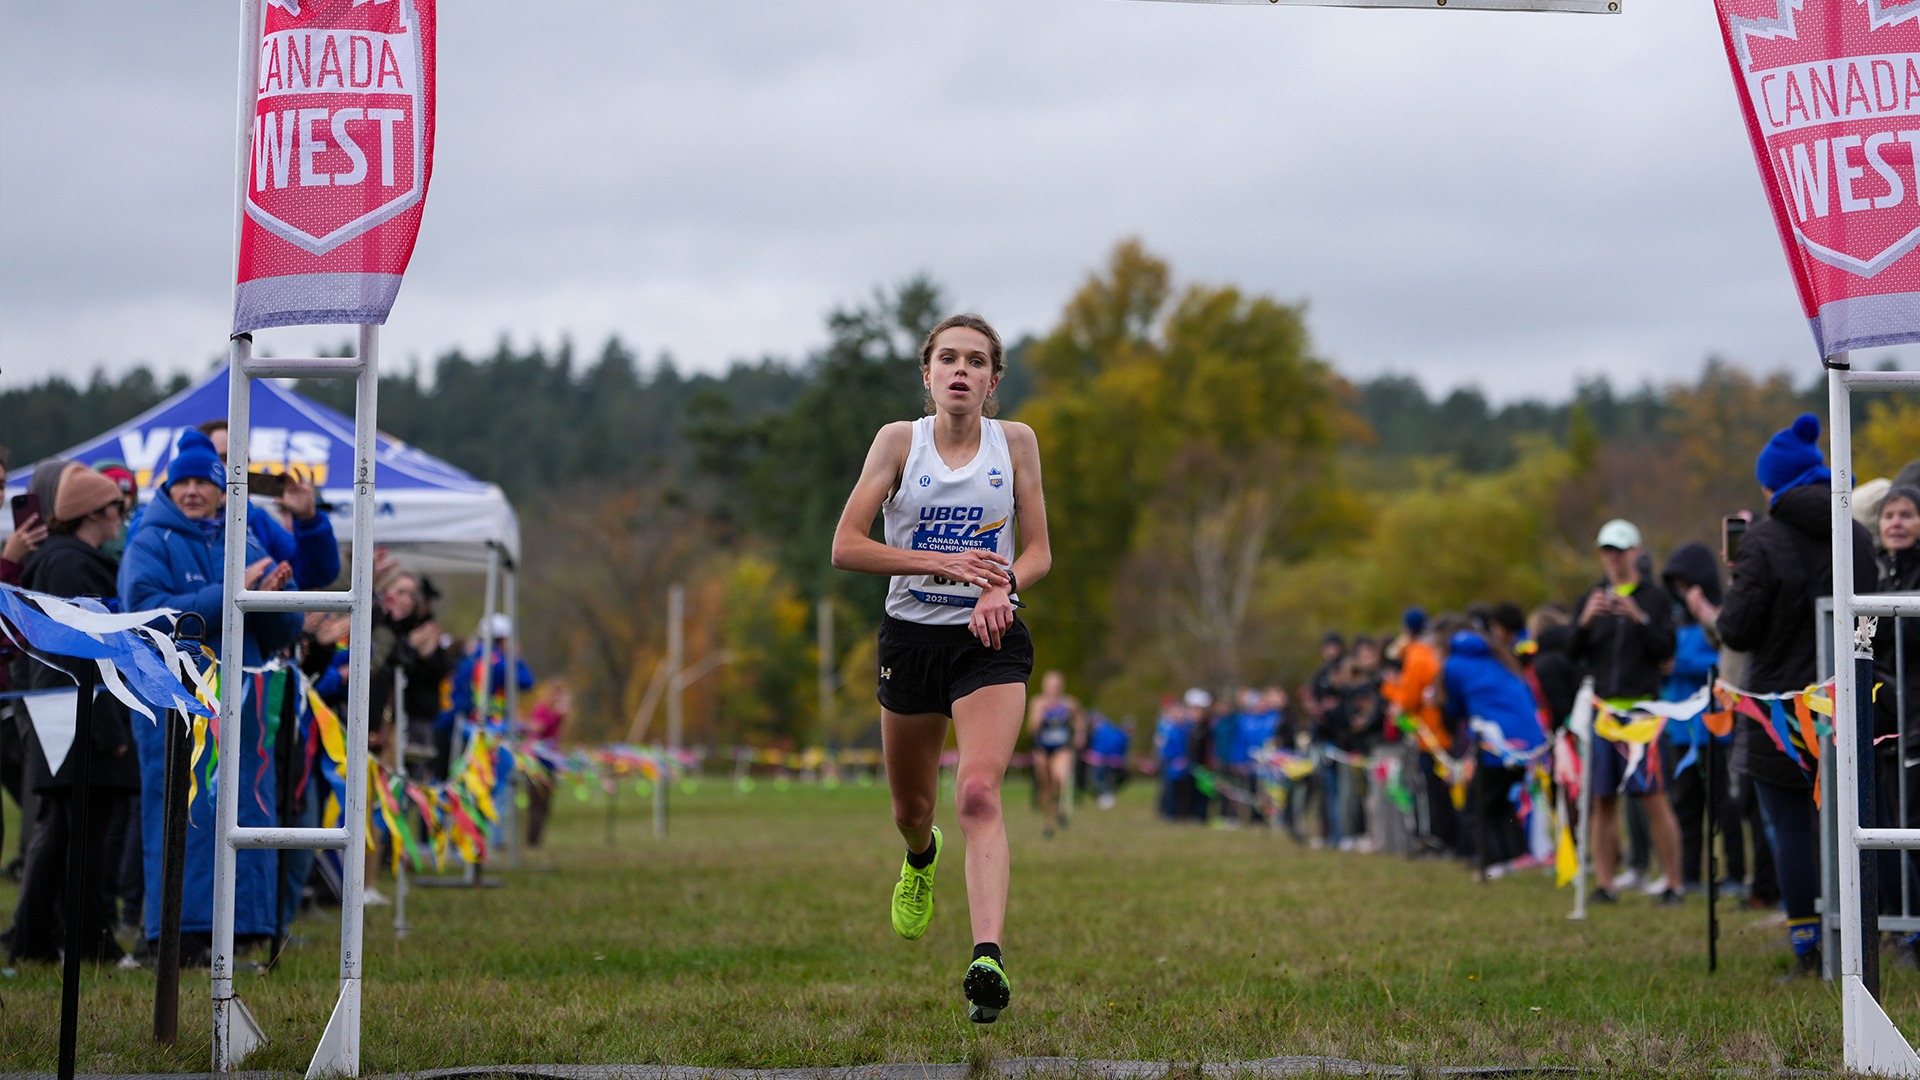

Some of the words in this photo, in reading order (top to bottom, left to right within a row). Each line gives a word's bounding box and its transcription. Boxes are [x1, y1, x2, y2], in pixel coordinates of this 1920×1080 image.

[258, 34, 404, 95] CANADA
[1760, 57, 1920, 128] CANADA
[255, 107, 405, 193] WEST
[1778, 129, 1920, 224] WEST
[919, 506, 984, 521] UBCO
[926, 536, 960, 546] CANADA
[961, 539, 984, 547] WEST
[925, 594, 949, 604] 2025
